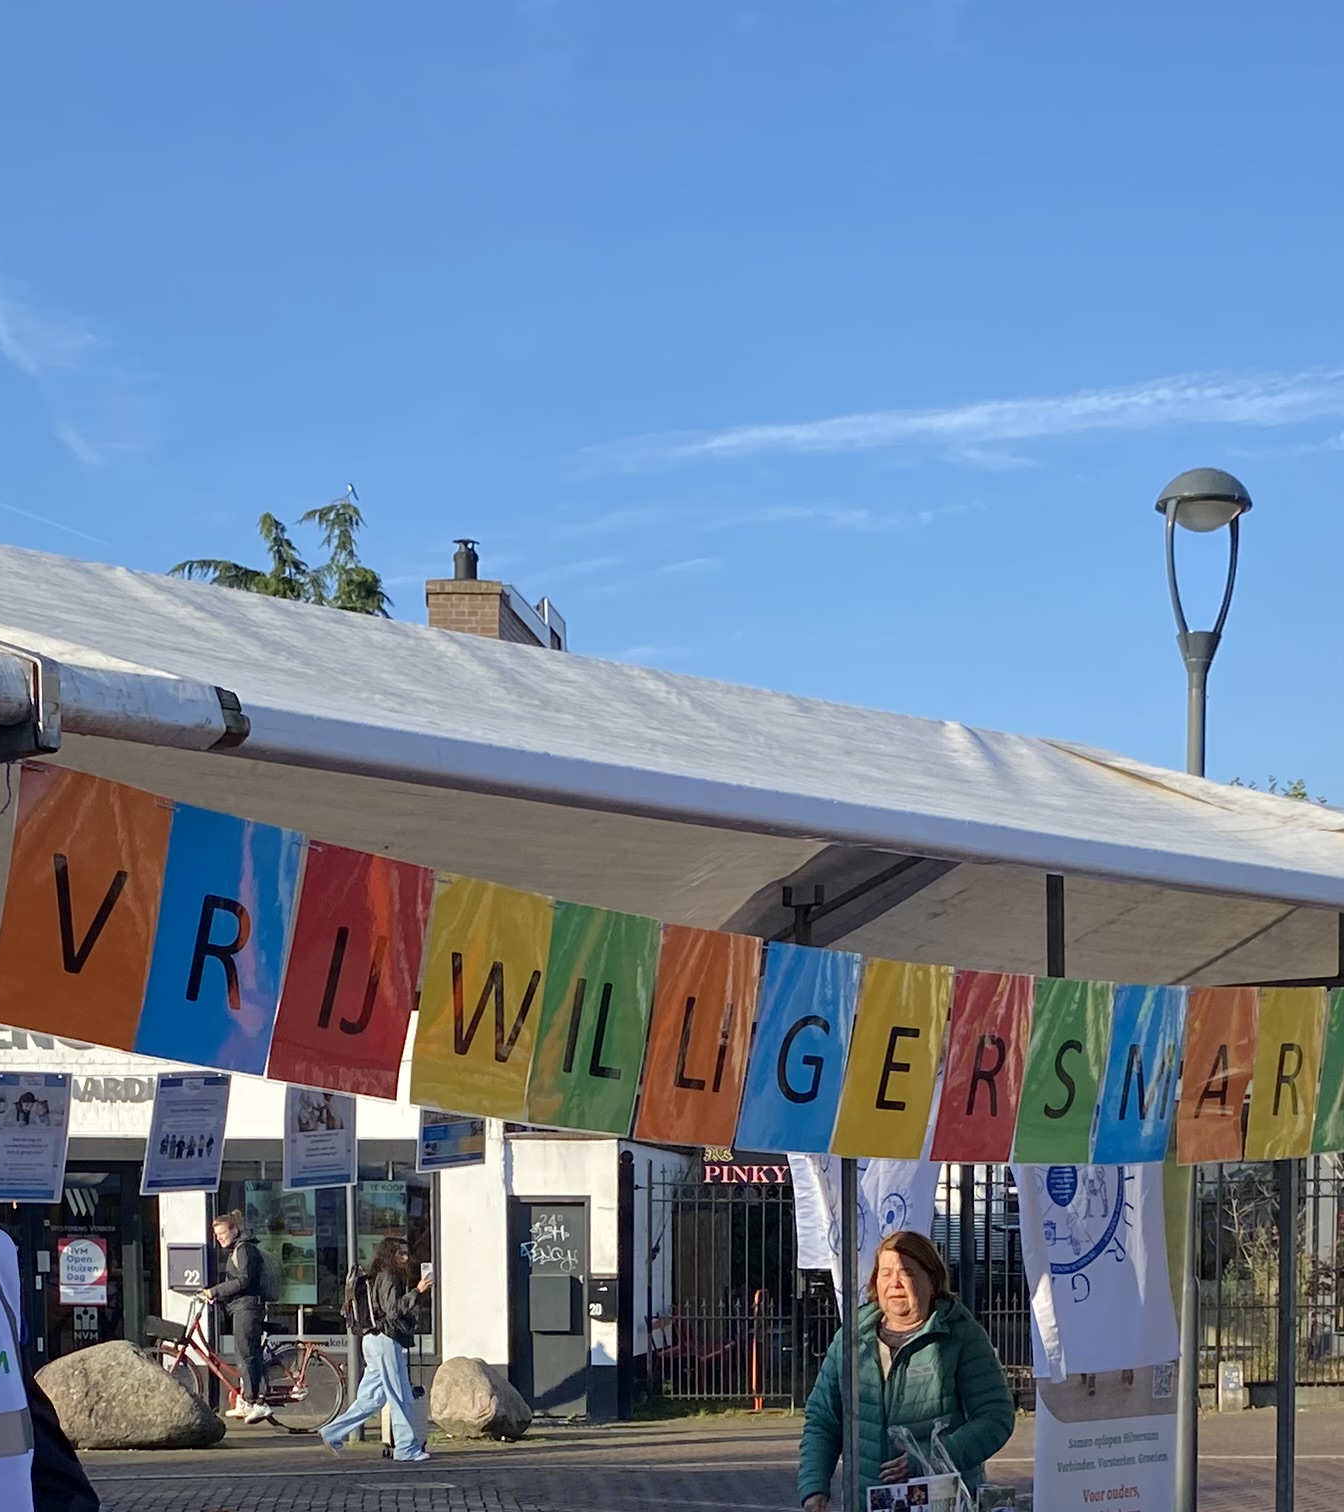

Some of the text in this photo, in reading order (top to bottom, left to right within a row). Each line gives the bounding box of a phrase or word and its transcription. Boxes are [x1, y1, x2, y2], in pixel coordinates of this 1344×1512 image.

[703, 1165, 789, 1183] PINKY
[67, 1247, 88, 1255] NVM
[67, 1255, 92, 1264] Open
[67, 1264, 99, 1272] Huizen
[67, 1274, 85, 1282] Dag
[184, 1270, 200, 1285] 22
[74, 1332, 98, 1340] NVM
[1068, 1431, 1159, 1449] Samen oplopen Hilversum
[1057, 1459, 1096, 1473] Verbinden.
[1082, 1484, 1140, 1503] Voor ouders,
